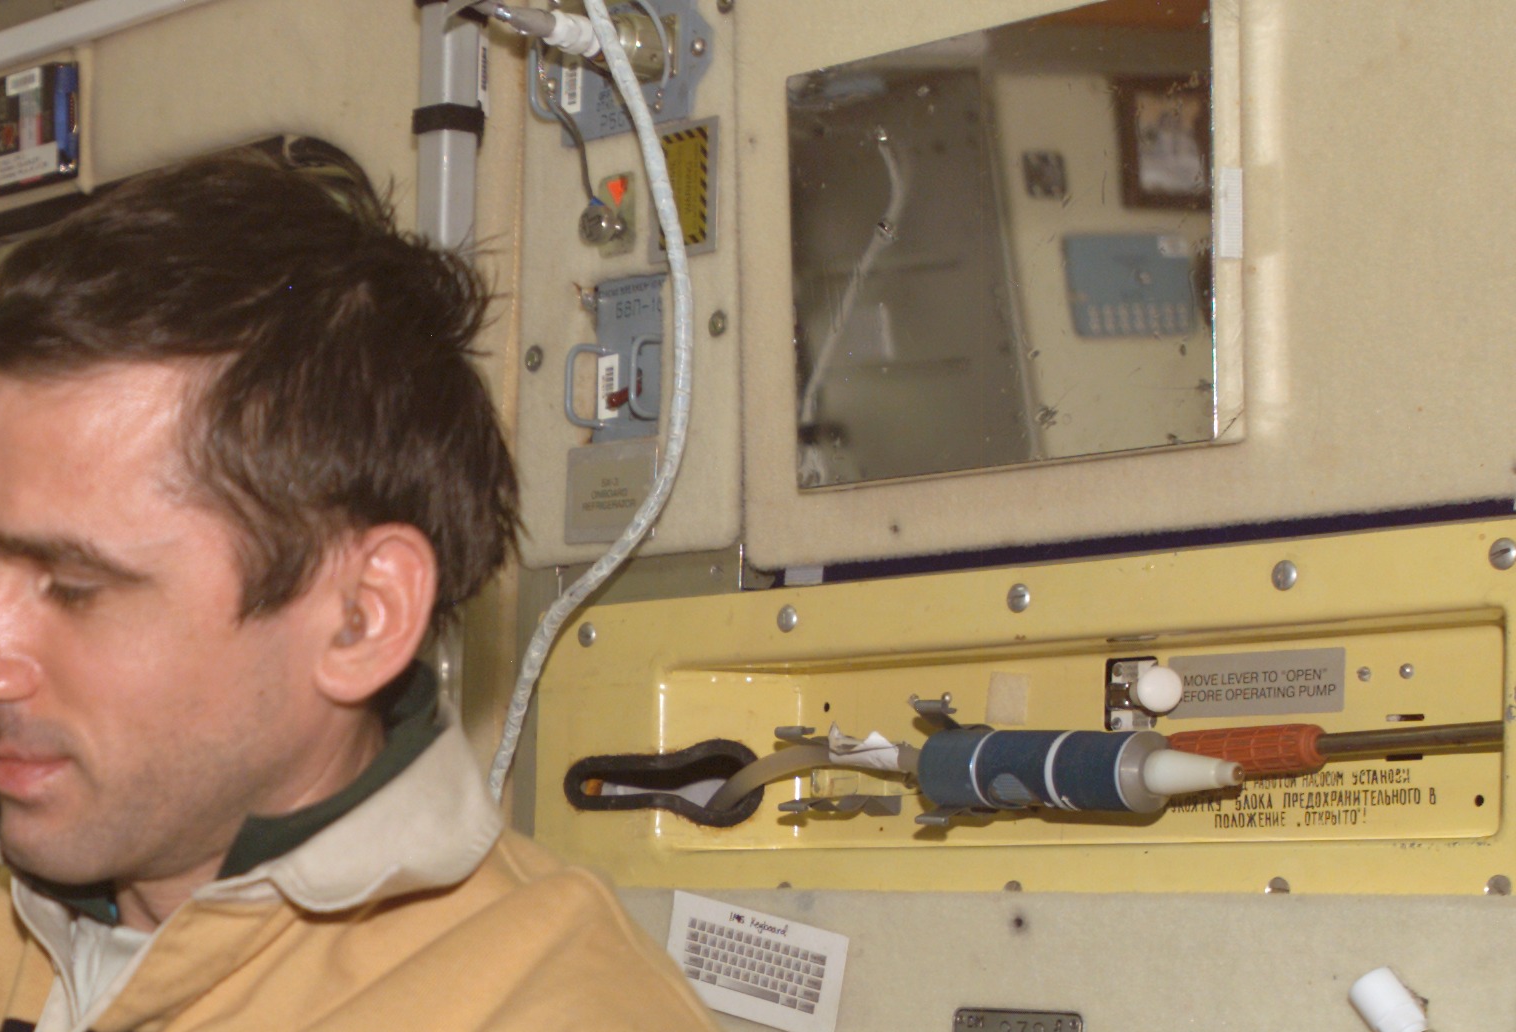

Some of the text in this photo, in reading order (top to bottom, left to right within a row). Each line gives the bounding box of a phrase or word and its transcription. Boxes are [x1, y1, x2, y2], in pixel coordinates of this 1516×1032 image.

[1183, 673, 1218, 687] MOVE
[1221, 671, 1259, 685] LEVER
[1262, 670, 1278, 683] TO
[1180, 683, 1336, 703] EFORE OPERATING PUMP
[1214, 811, 1287, 829] ПОЛОЖЕНИЕ
[750, 917, 789, 937] Keyboard
